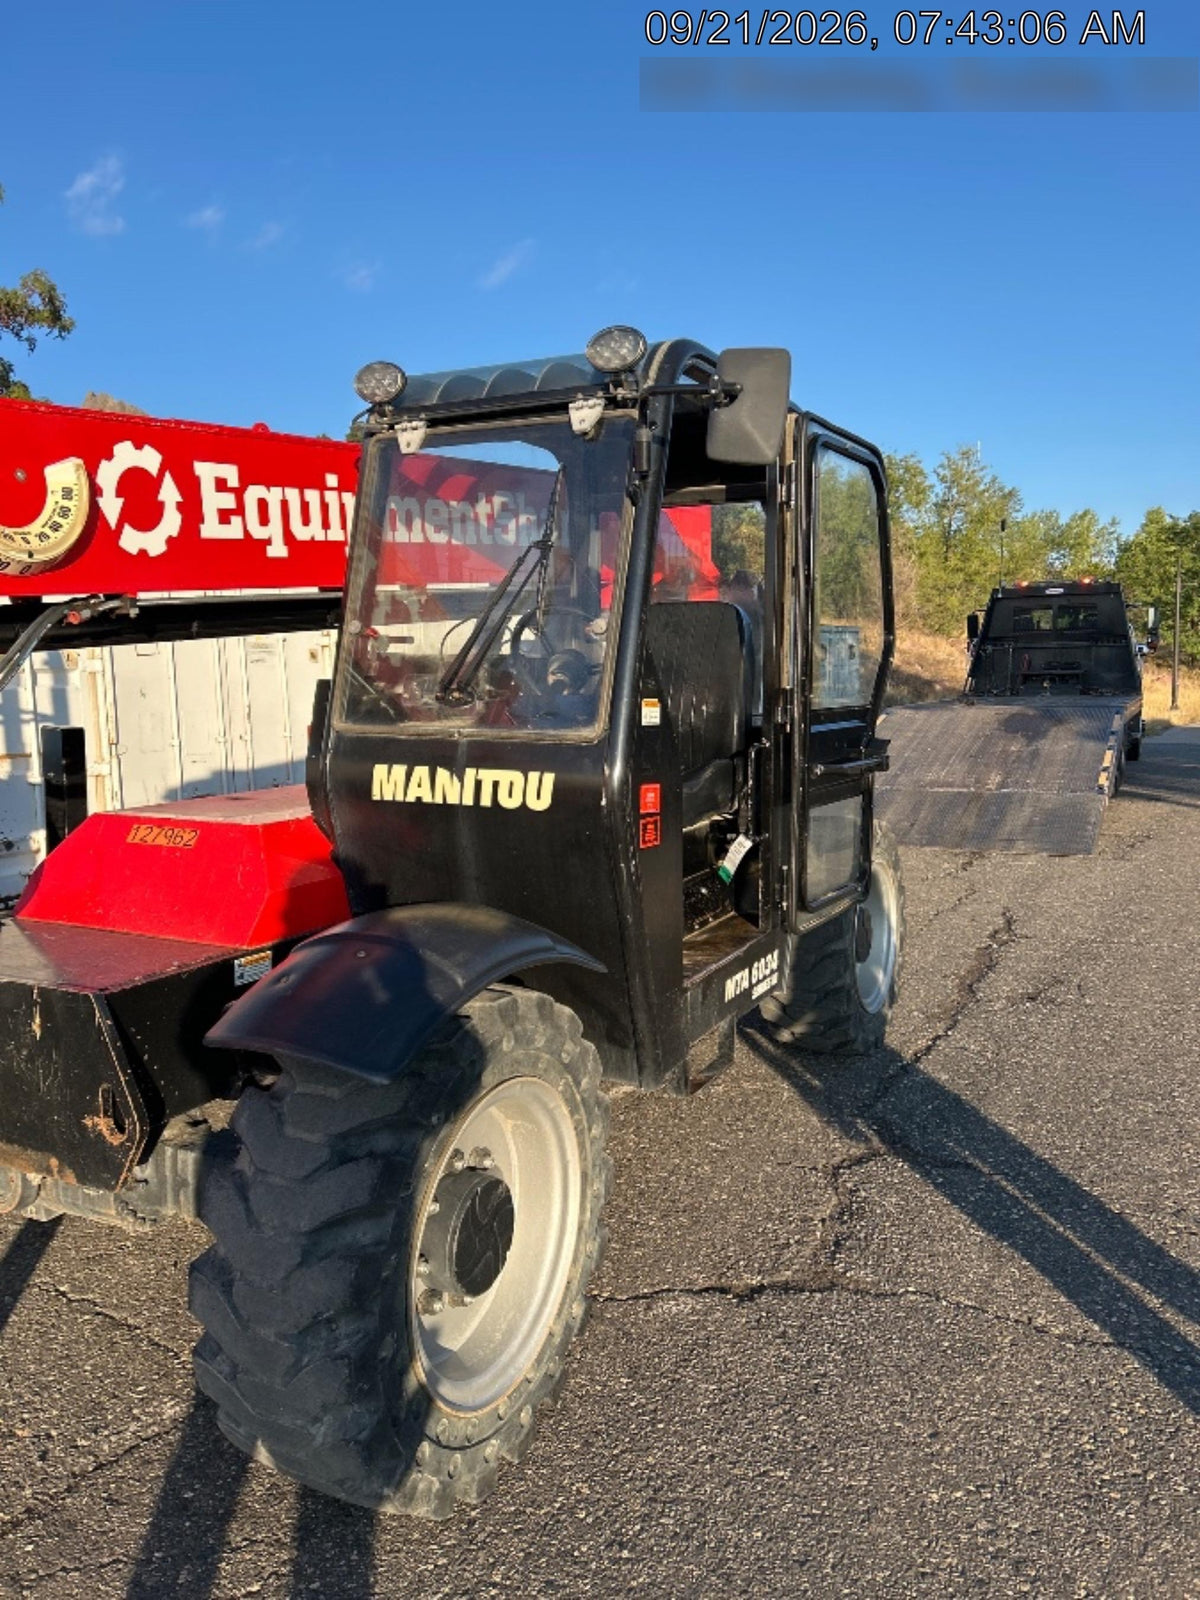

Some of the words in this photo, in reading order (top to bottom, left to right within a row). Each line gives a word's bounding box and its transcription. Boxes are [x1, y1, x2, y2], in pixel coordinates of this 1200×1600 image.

[371, 764, 556, 811] MANITOU
[131, 825, 198, 847] 127962
[725, 967, 749, 1003] MTA
